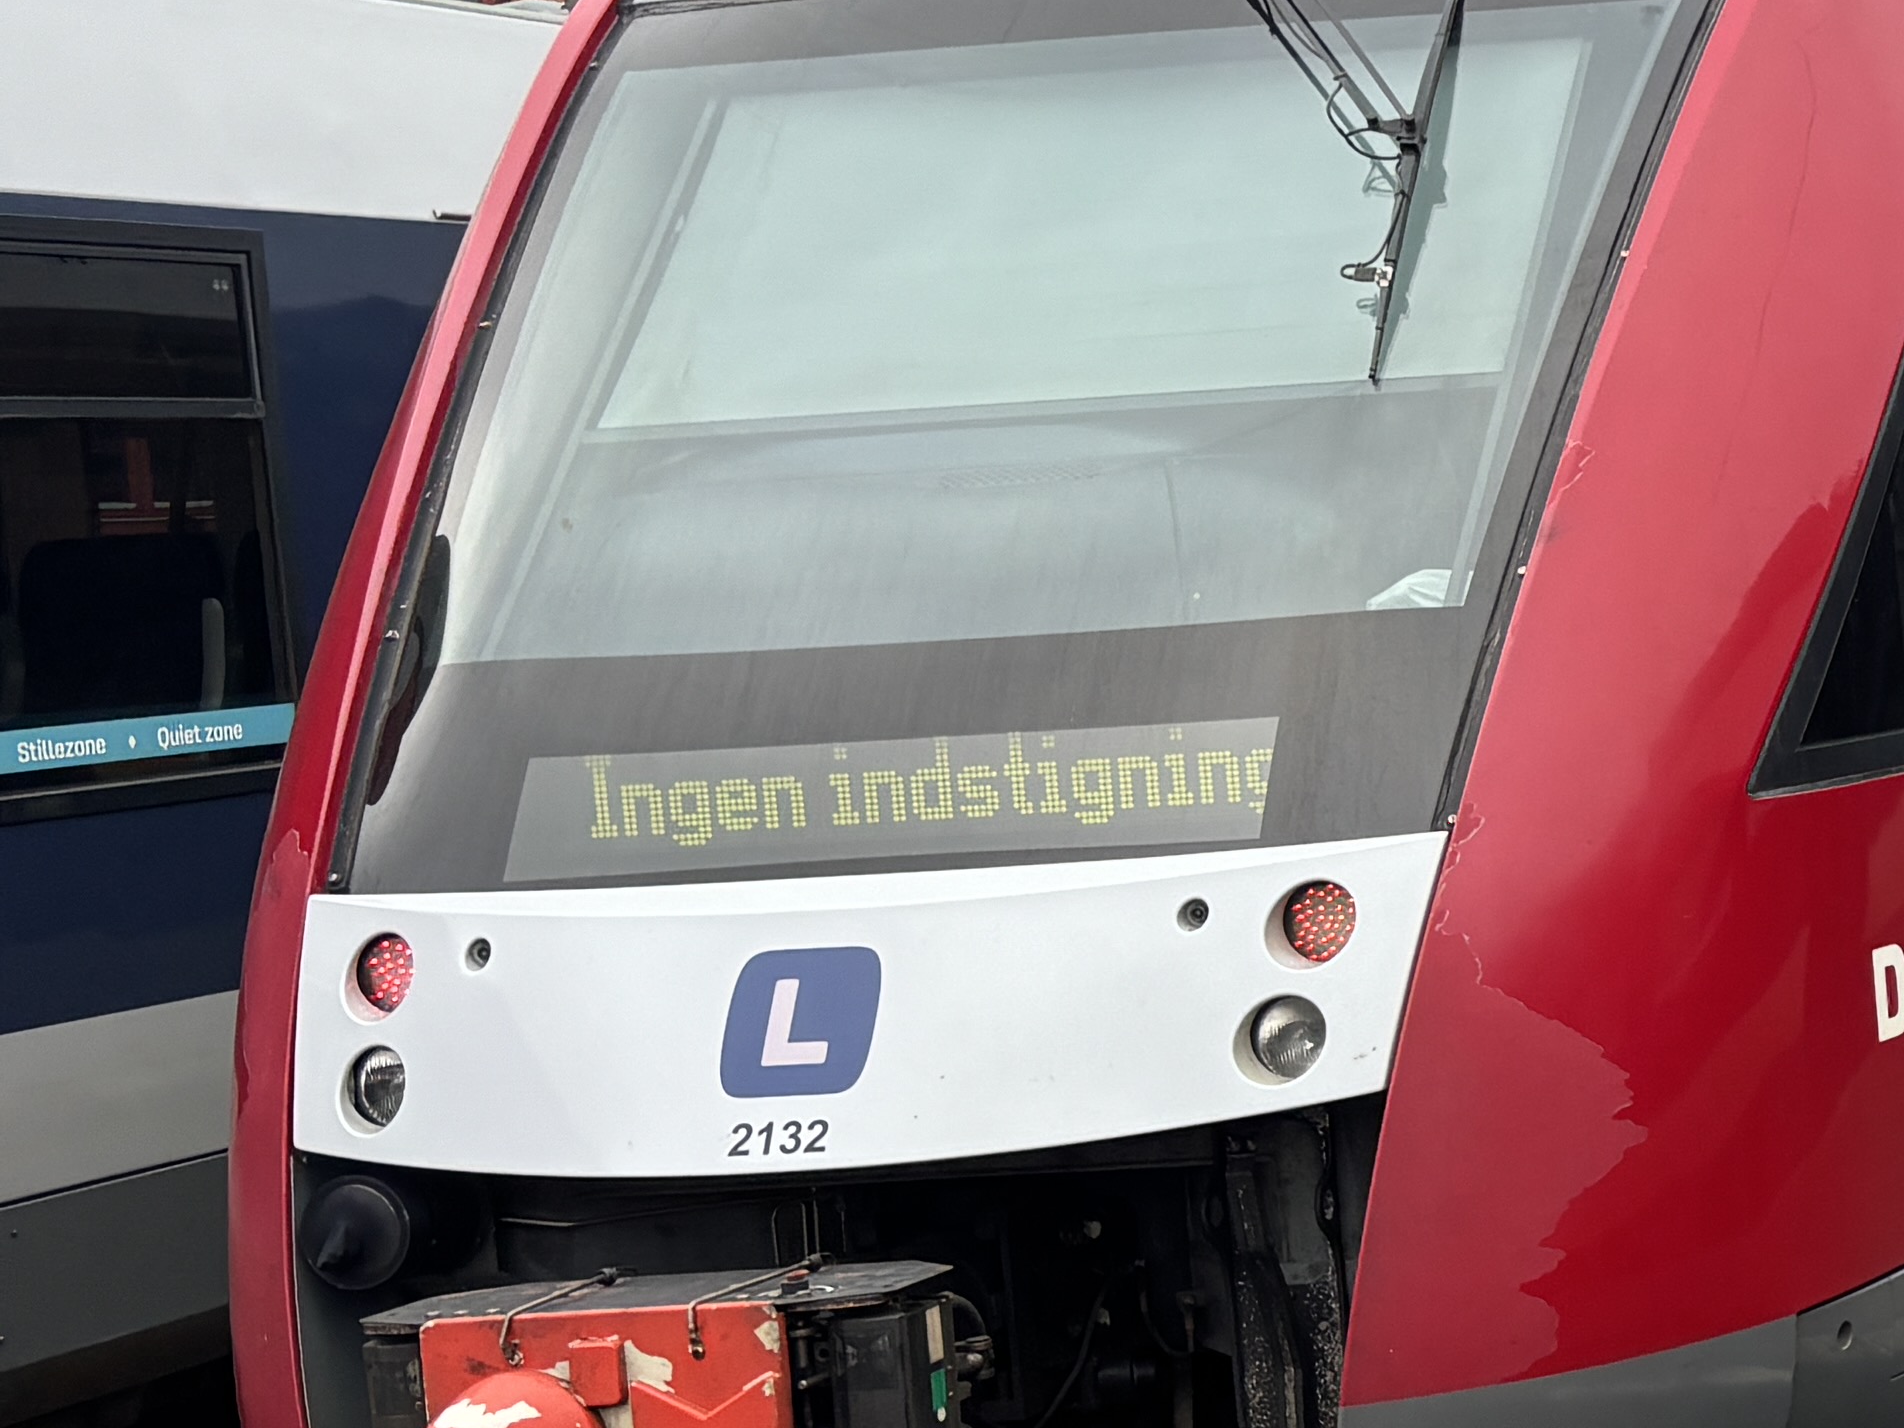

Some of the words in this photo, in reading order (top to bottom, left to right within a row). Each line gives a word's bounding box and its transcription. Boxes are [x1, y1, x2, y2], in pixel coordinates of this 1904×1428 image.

[17, 737, 107, 764] Stillezone
[157, 724, 202, 750] Quiet
[204, 723, 243, 743] zone
[585, 754, 807, 846] Ingen
[761, 978, 829, 1067] L
[727, 1119, 829, 1157] 2132
